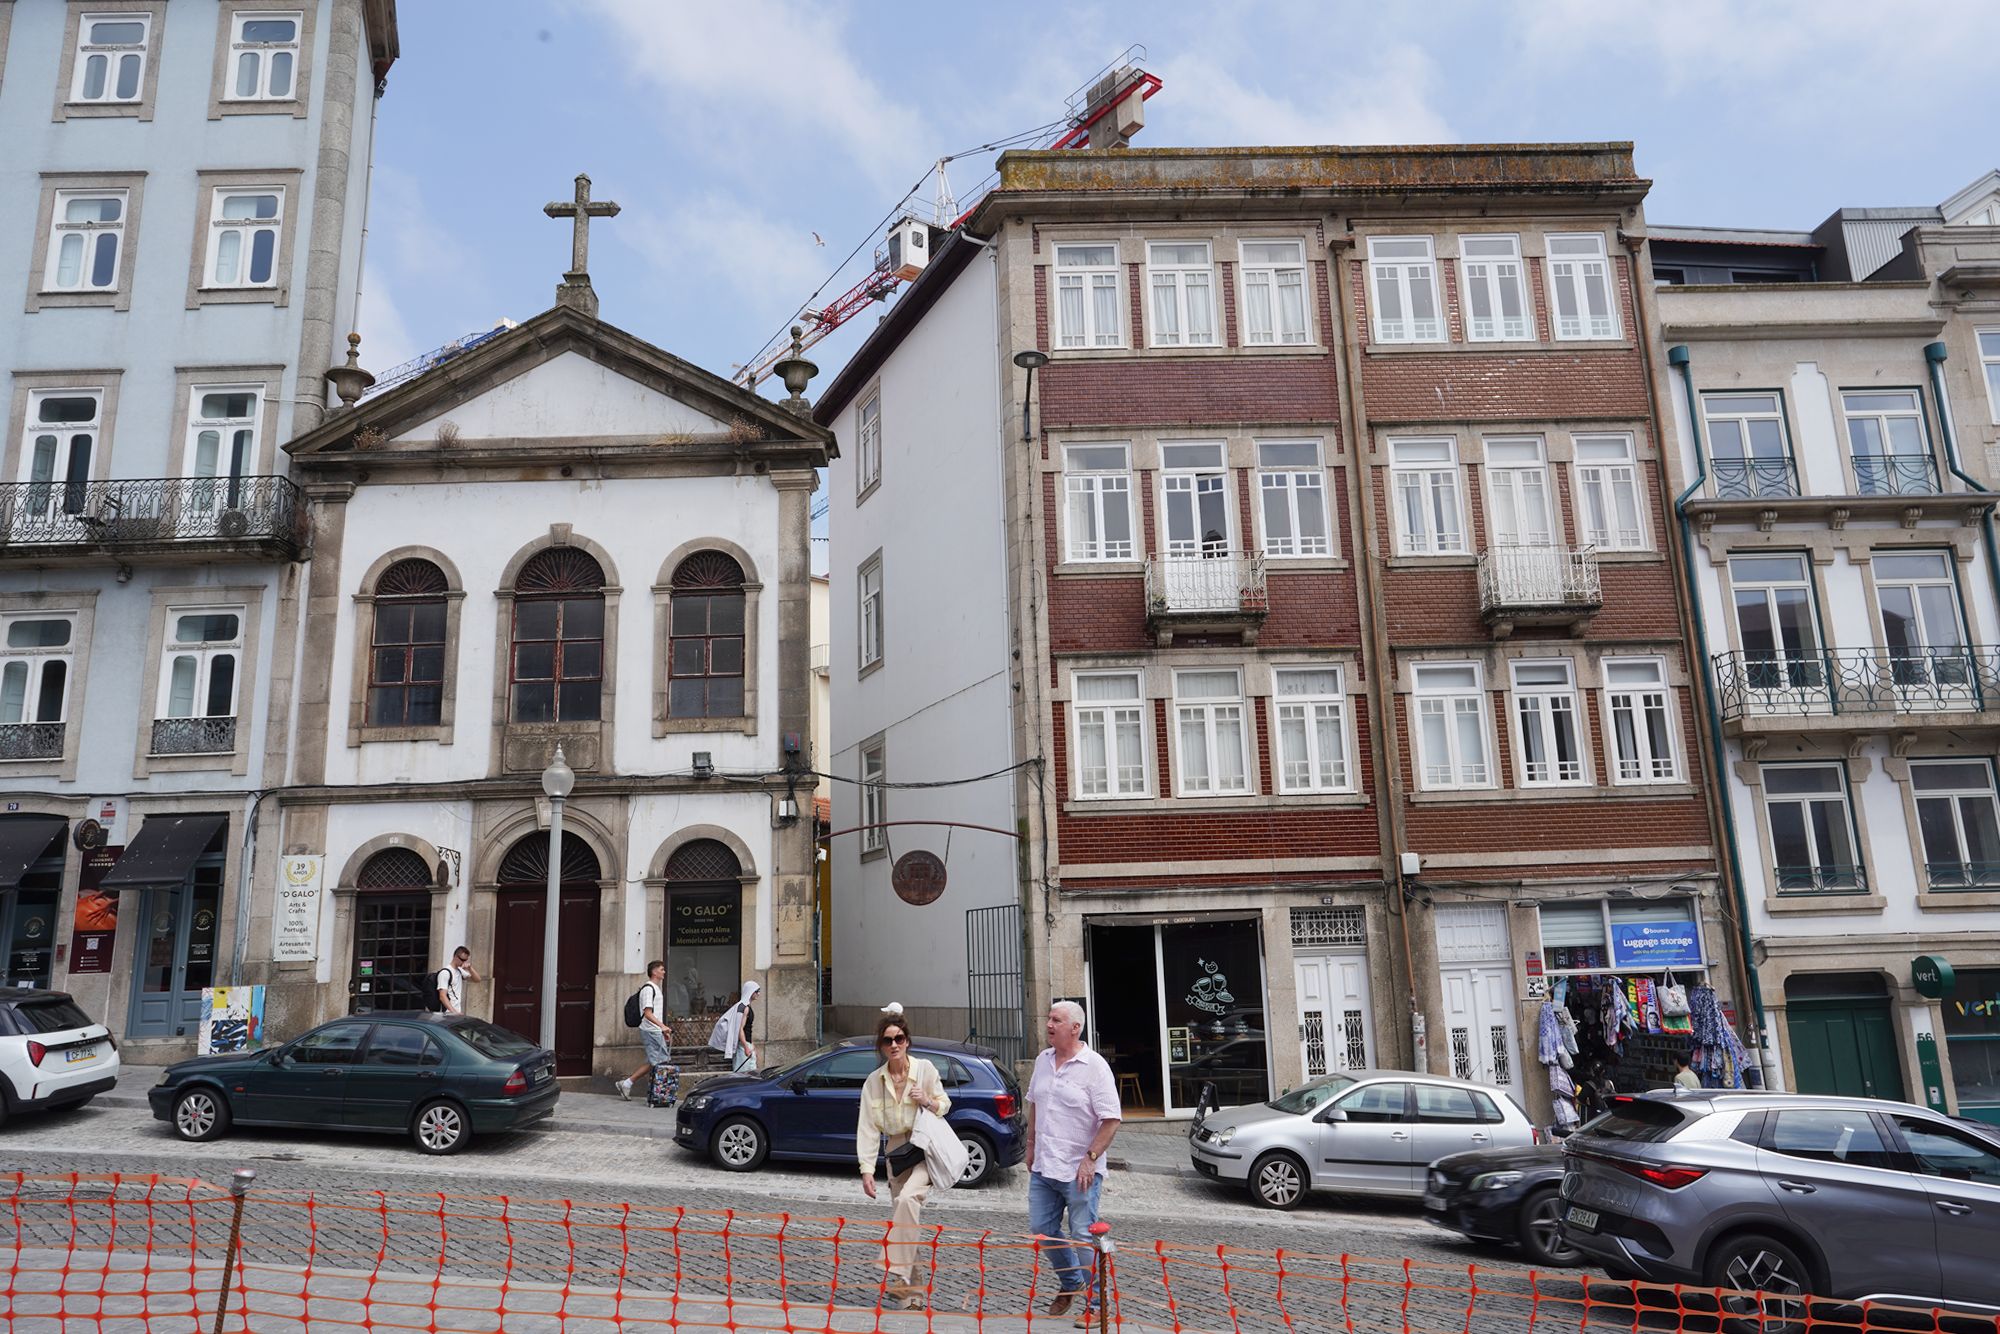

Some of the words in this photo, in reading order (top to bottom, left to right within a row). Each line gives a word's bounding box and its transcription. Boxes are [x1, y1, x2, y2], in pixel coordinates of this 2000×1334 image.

[1622, 938, 1659, 948] Luggage
[1660, 937, 1693, 946] storage
[1916, 968, 1938, 982] vert.
